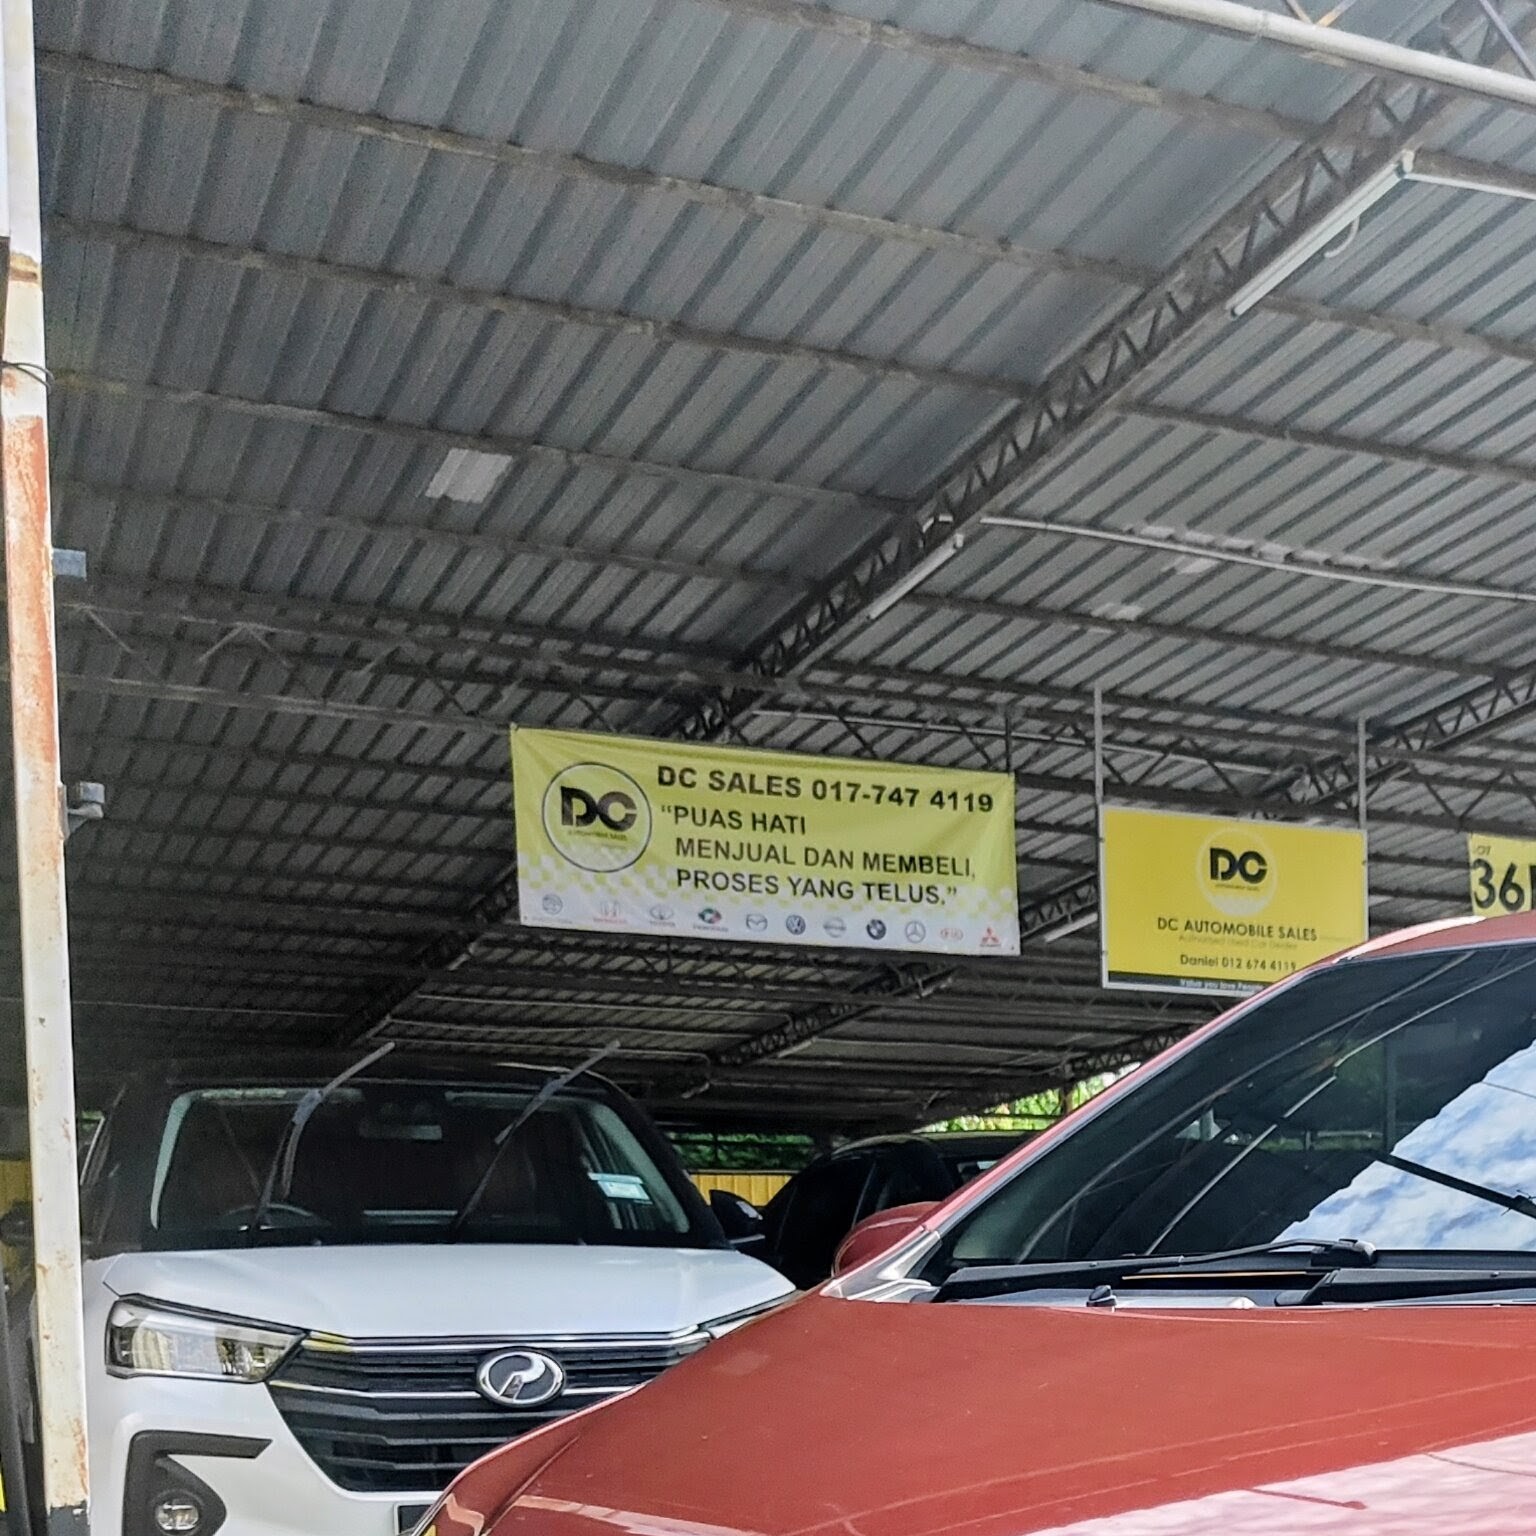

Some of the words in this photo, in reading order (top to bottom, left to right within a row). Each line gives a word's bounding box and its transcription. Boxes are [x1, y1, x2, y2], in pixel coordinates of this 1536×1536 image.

[658, 765, 697, 788] DC
[709, 770, 801, 798] SALES
[812, 780, 920, 807] 017-747
[930, 790, 993, 812] 4119
[560, 786, 637, 832] DC
[752, 812, 806, 835] HATI
[676, 837, 796, 865] MENJUAL
[804, 847, 854, 869] DAN
[863, 852, 976, 879] MEMBELI,
[1210, 848, 1268, 884] DC
[677, 868, 779, 895] PROSES
[787, 876, 854, 900] YANG
[1157, 917, 1178, 931] DC
[1184, 919, 1274, 939] AUTOMOBILE
[1278, 926, 1318, 942] SALES
[1180, 954, 1218, 967] Daniel
[1221, 957, 1242, 969] 012
[1246, 958, 1266, 971] 674
